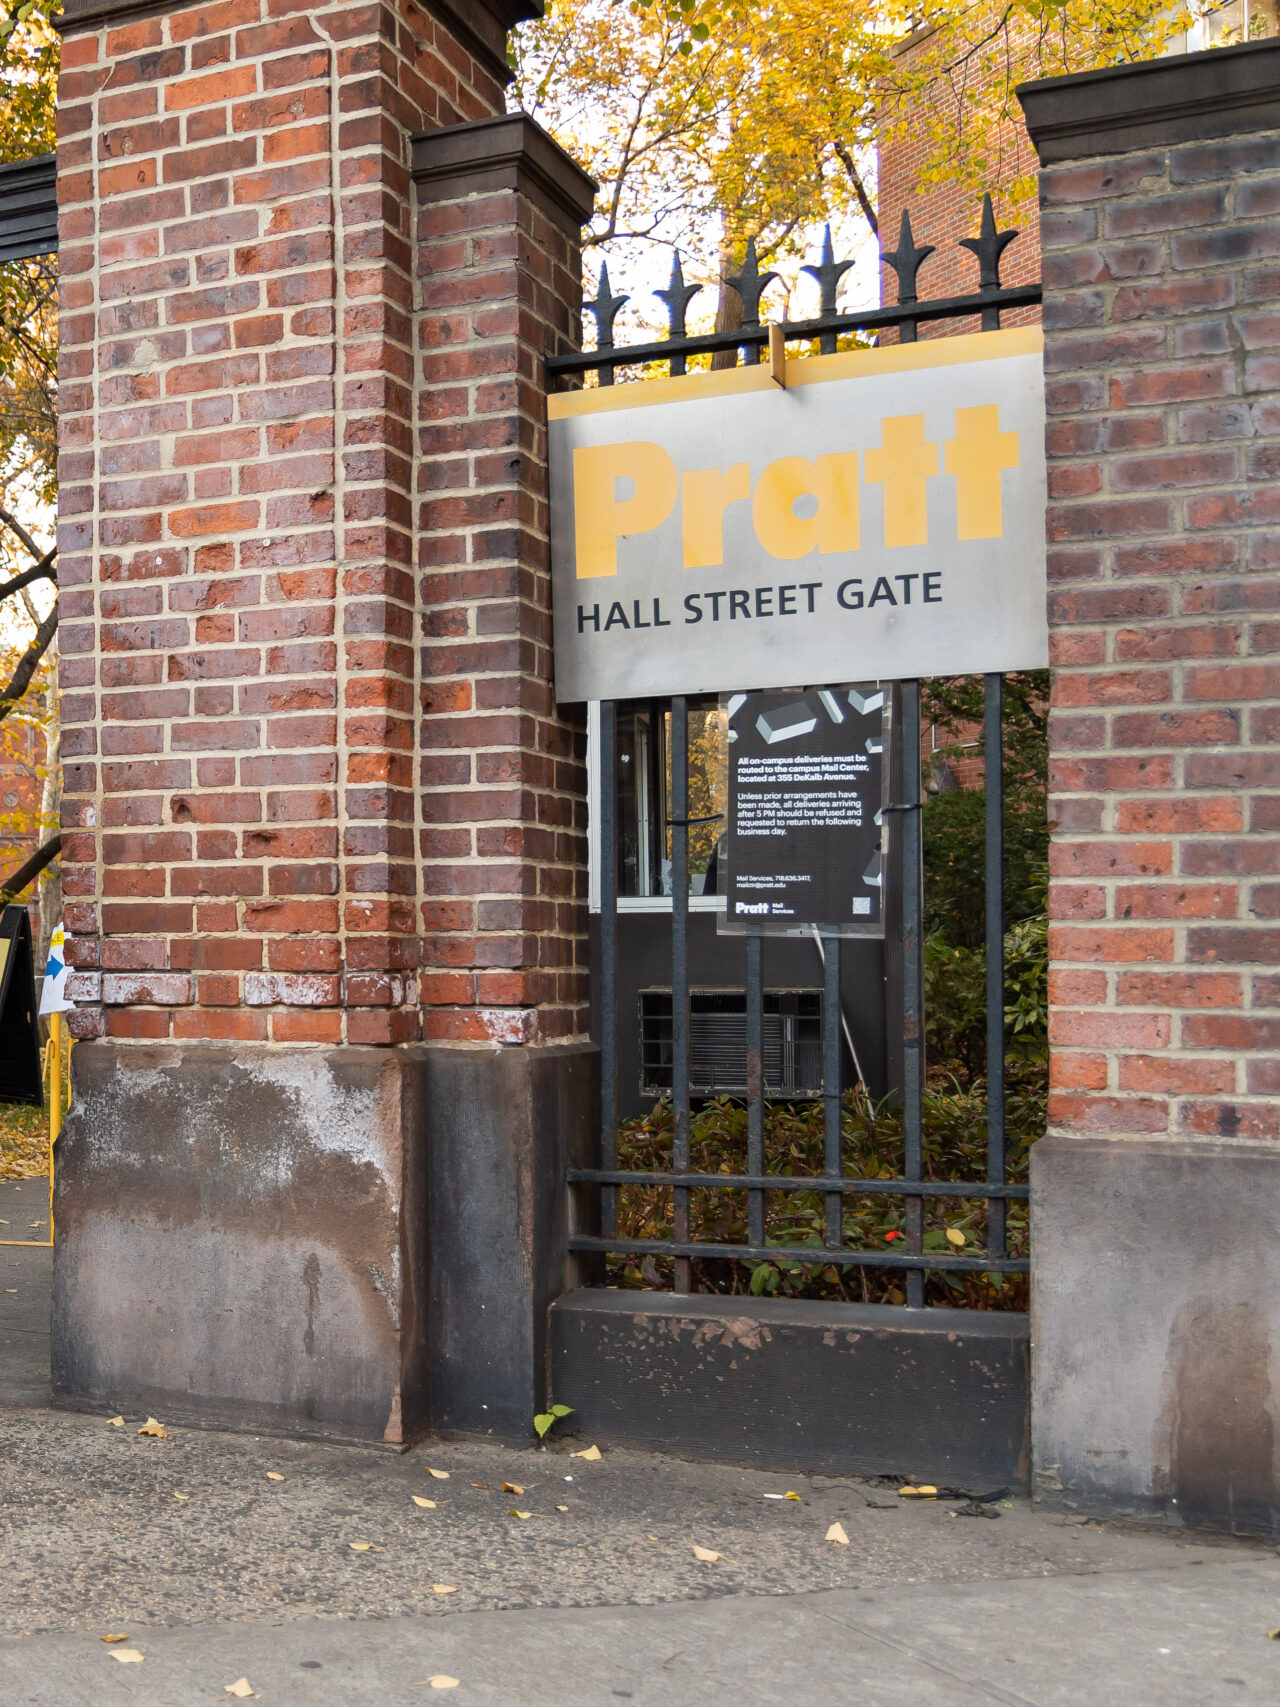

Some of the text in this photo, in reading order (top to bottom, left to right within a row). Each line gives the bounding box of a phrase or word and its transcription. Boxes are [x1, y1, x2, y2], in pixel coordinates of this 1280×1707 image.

[573, 404, 1019, 580] Pratt
[577, 571, 943, 634] HALL STREET GATE
[738, 757, 748, 765] All
[750, 756, 793, 765] on-campus
[738, 766, 764, 774] routed
[788, 766, 820, 774] campus
[794, 773, 822, 781] DeKalb
[824, 773, 856, 781] Avenue.
[738, 792, 762, 800] Unless
[764, 792, 782, 801] prior
[783, 792, 837, 800] arrangements
[758, 801, 781, 809] made,
[783, 800, 792, 808] all
[794, 800, 830, 808] deliveries
[832, 800, 861, 809] arriving
[737, 810, 755, 818] after
[737, 819, 775, 827] requested
[826, 818, 861, 826] following
[771, 828, 786, 836] day.
[736, 902, 768, 913] Pratt
